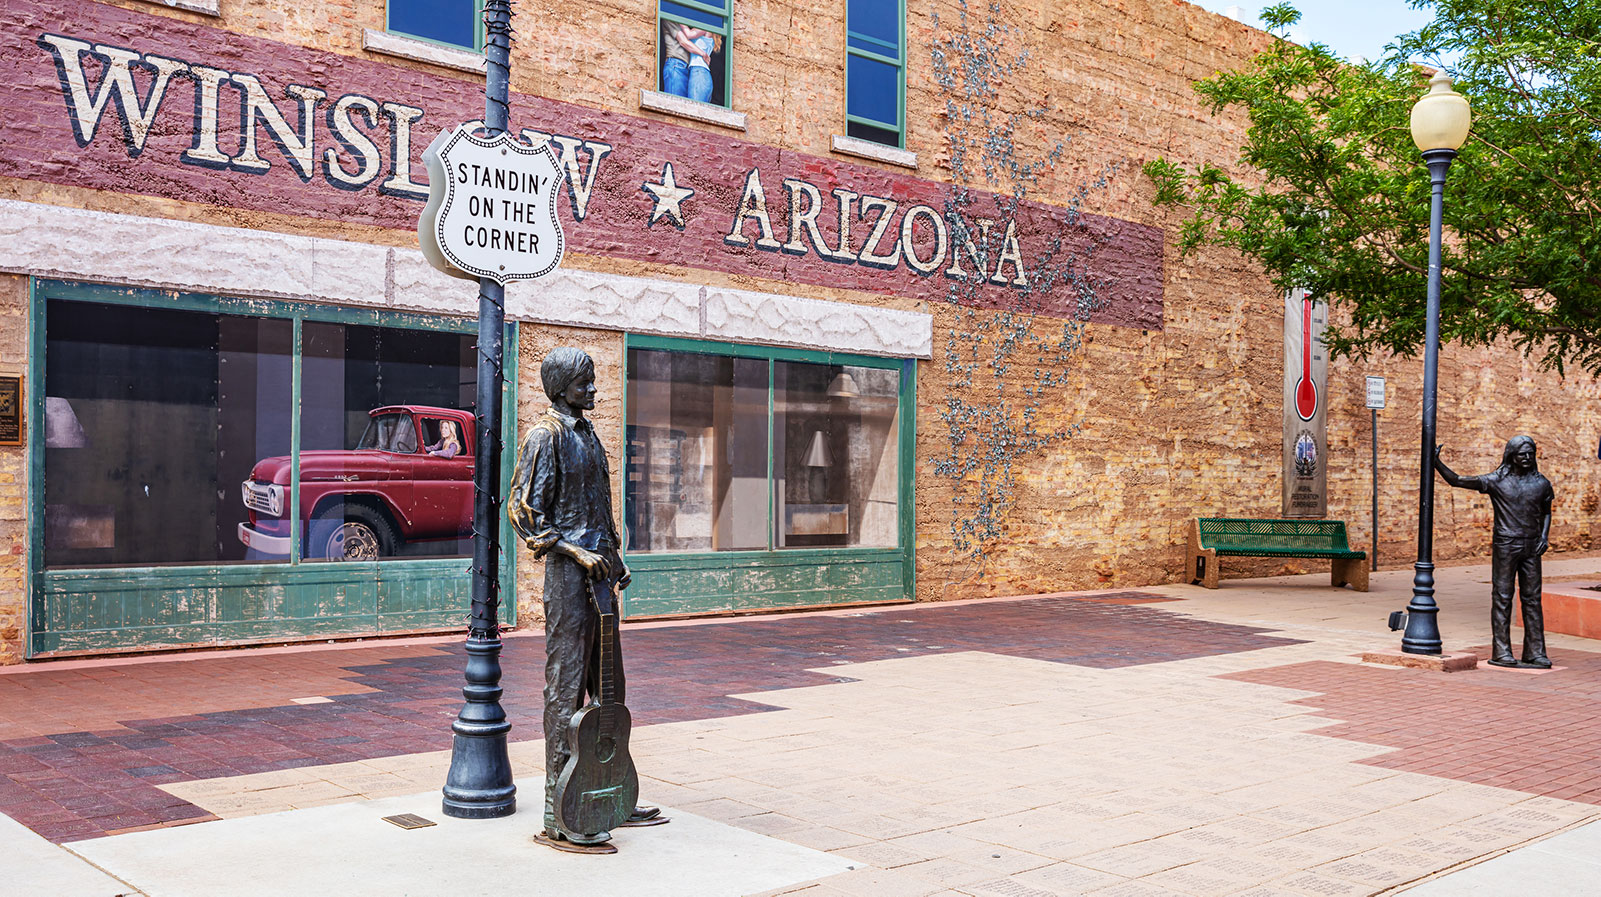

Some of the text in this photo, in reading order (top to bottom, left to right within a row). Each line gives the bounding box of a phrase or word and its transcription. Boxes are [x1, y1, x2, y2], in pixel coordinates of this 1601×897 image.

[38, 33, 1029, 290] WINSLW ARIZONA
[458, 163, 548, 195] STANDIN'
[469, 196, 536, 225] ON THE
[464, 225, 540, 255] CORNER
